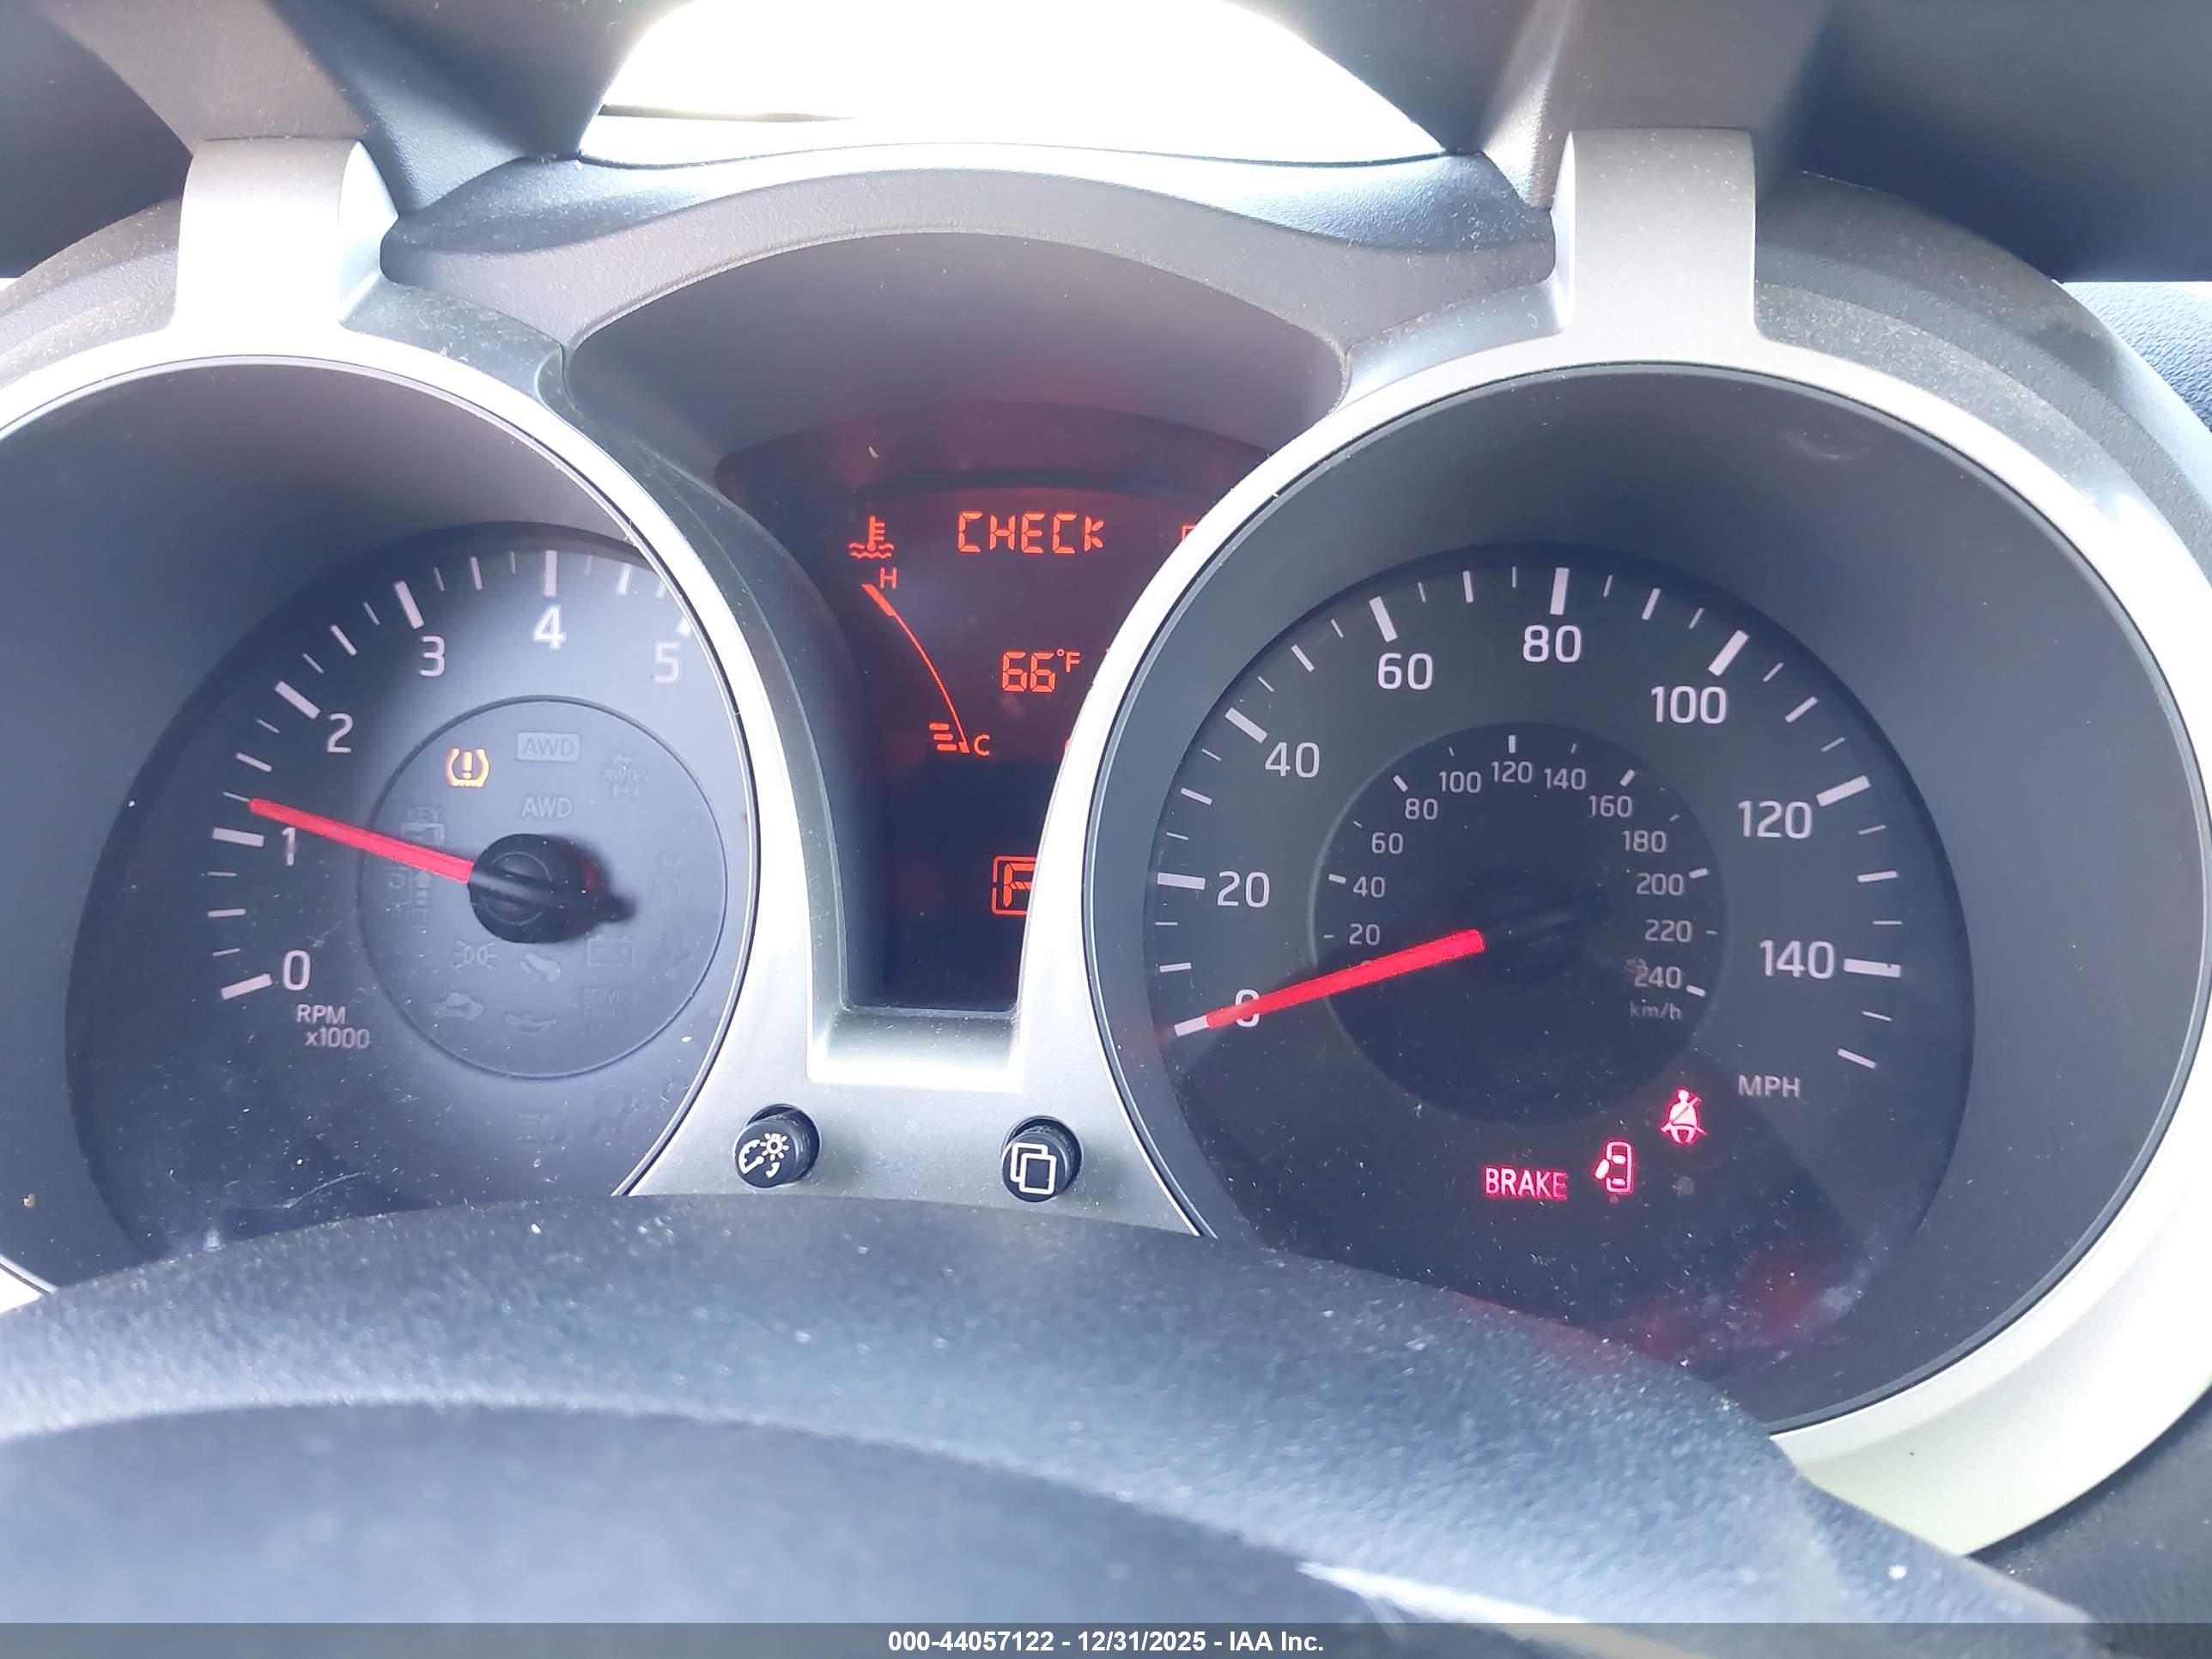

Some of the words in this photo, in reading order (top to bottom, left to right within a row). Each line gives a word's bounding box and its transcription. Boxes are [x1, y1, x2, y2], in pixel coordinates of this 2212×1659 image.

[957, 511, 1104, 553] CHECK
[879, 568, 897, 589] H
[532, 606, 567, 650] 4
[1522, 624, 1583, 663] 80
[419, 635, 446, 678] 3
[653, 640, 682, 684] 5
[1376, 653, 1434, 690] 60
[1650, 685, 1728, 725] 100
[326, 713, 353, 754] 2
[522, 738, 575, 757] AWD
[973, 735, 991, 757] C
[1264, 741, 1321, 778] 40
[1439, 769, 1482, 793] 100
[1492, 761, 1534, 783] 120
[1545, 768, 1587, 790] 140
[521, 796, 573, 818] AWD
[1405, 798, 1438, 820] 80
[1589, 794, 1632, 818] 160
[1737, 800, 1813, 839] 120
[282, 826, 296, 866] 1
[1371, 832, 1404, 854] 60
[1622, 830, 1667, 853] 180
[1216, 871, 1271, 907] 20
[1352, 876, 1385, 898] 40
[1636, 872, 1685, 896] 200
[1349, 923, 1381, 945] 20
[1644, 919, 1692, 943] 220
[283, 950, 311, 990] 0
[1759, 940, 1835, 978] 140
[1633, 965, 1682, 989] 240
[296, 1004, 347, 1024] RPM
[1235, 988, 1261, 1027] 0
[1630, 1000, 1682, 1020] km/h
[304, 1028, 371, 1049] x1000
[1737, 1075, 1801, 1098] MPH
[1484, 1167, 1568, 1200] BRAKE
